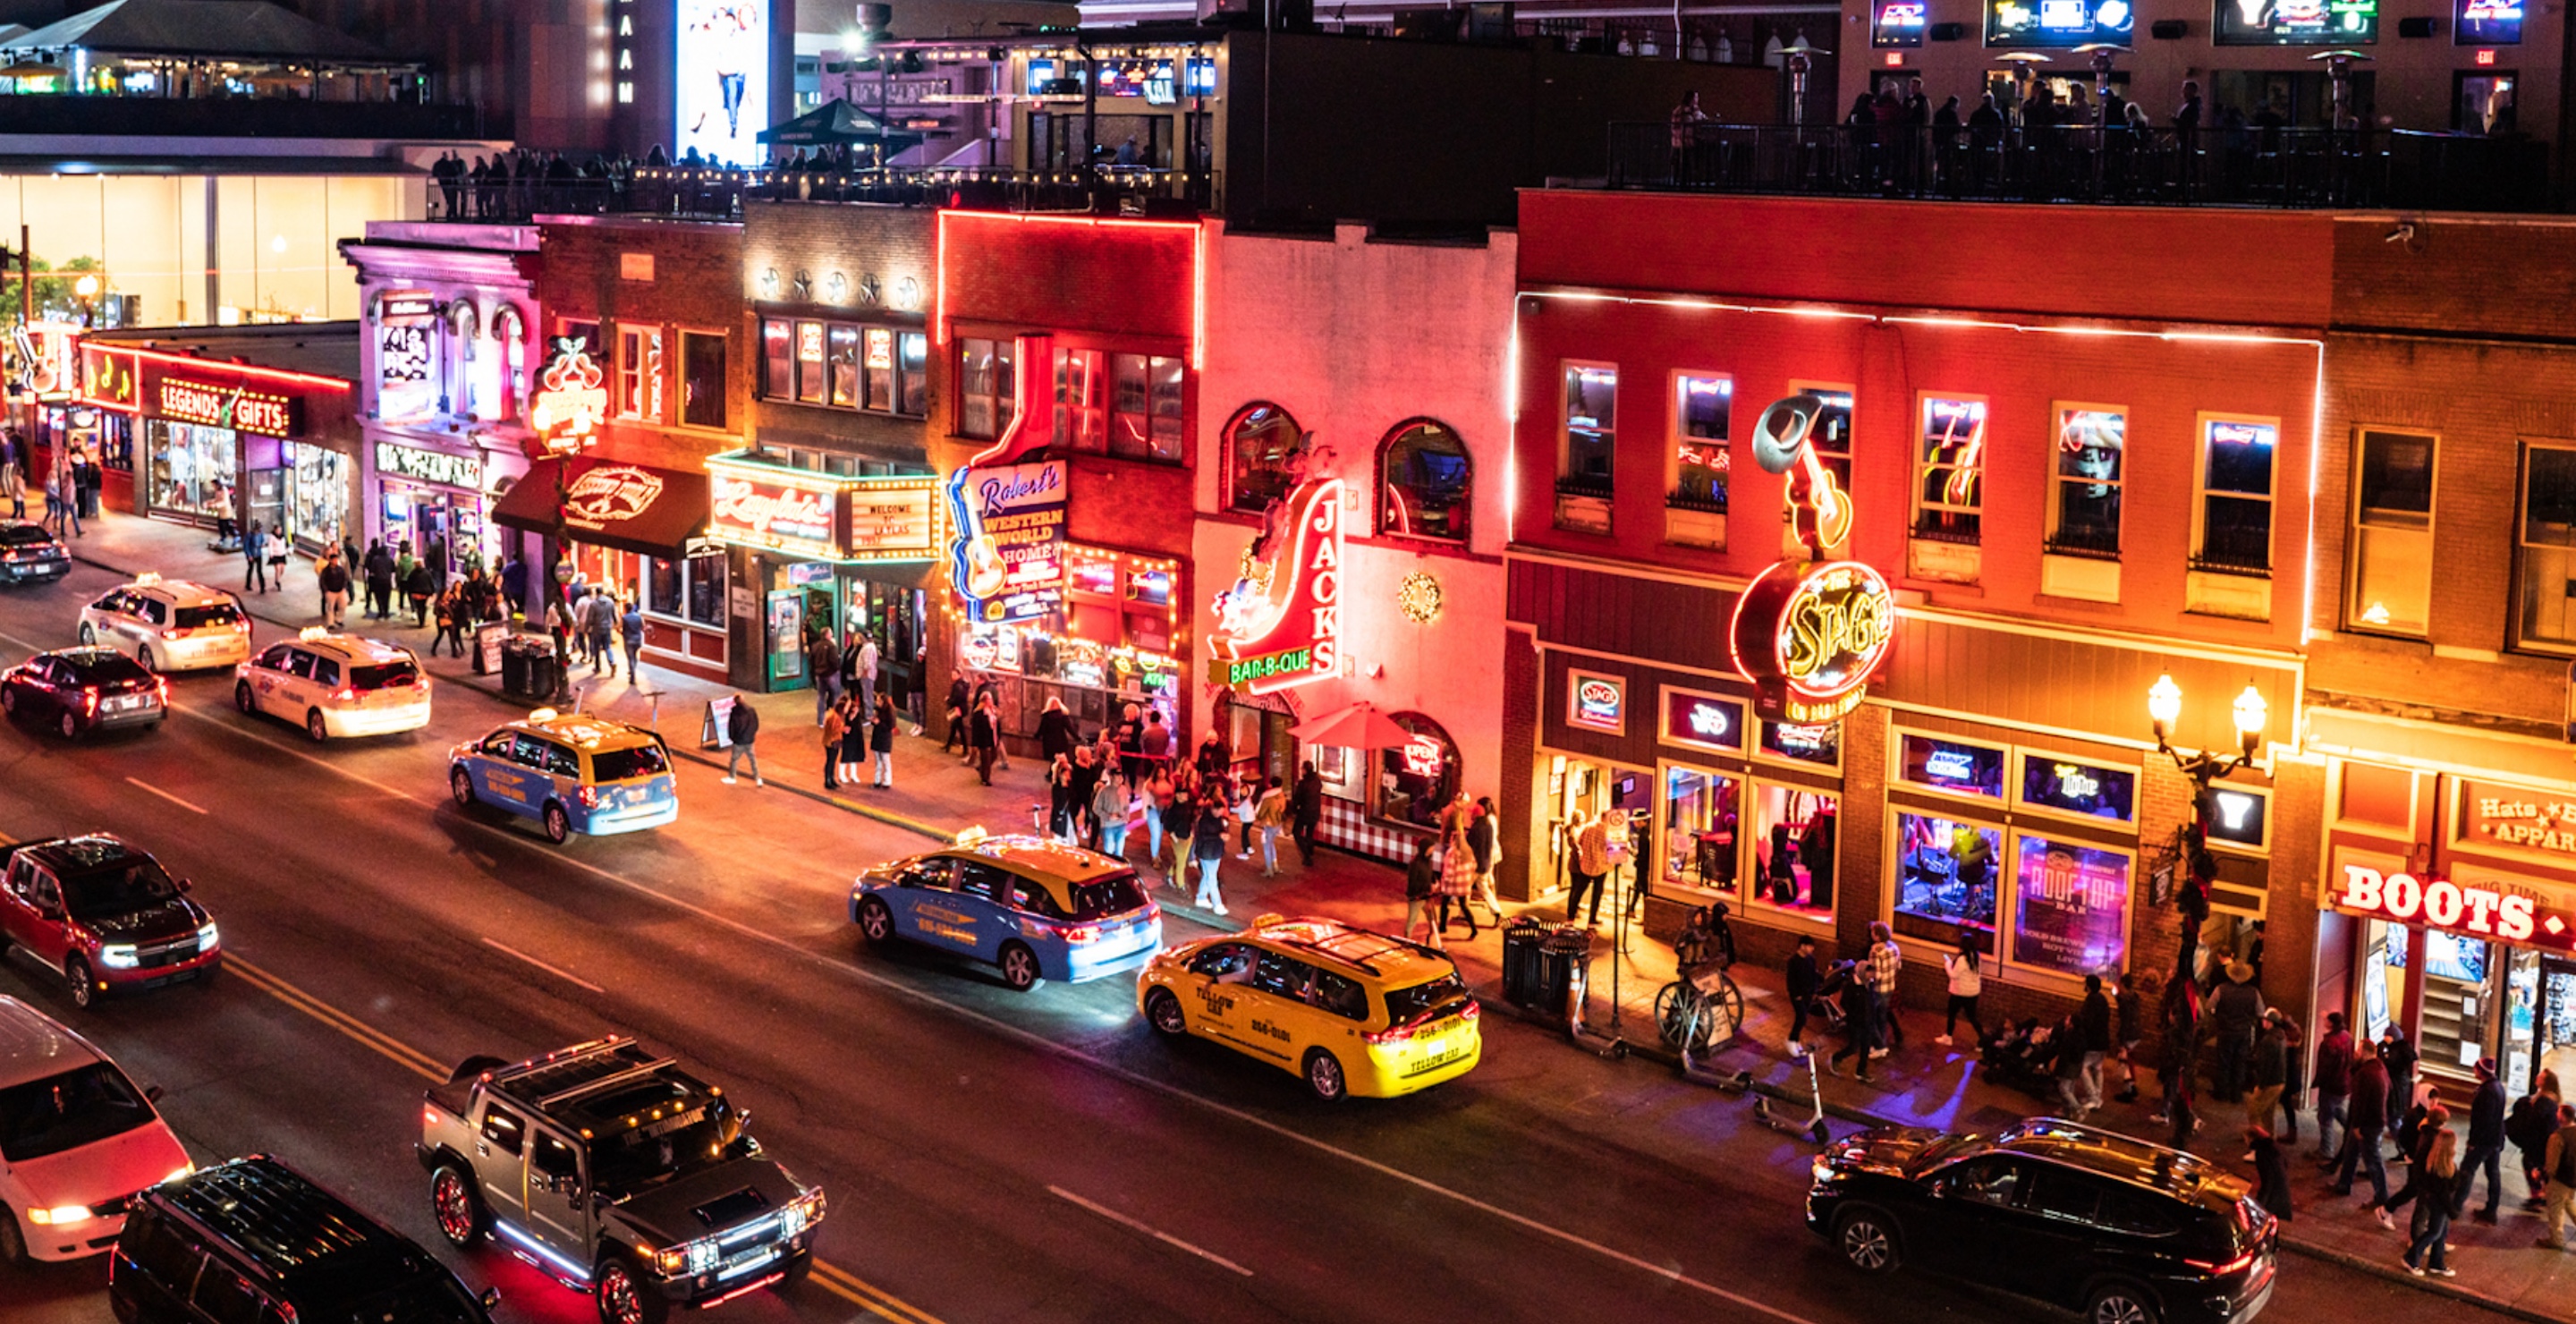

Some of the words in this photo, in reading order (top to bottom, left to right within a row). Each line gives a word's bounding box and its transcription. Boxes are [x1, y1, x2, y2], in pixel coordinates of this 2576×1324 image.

[163, 385, 220, 420] LEGENDS
[236, 398, 283, 429] GIFTS
[980, 464, 1060, 517] Robert's
[716, 480, 830, 533] Layla's
[869, 505, 911, 514] WELCOME
[983, 509, 1063, 532] WESTERN
[994, 526, 1054, 547] WORLD
[1004, 546, 1052, 564] HOME
[1309, 498, 1338, 675] JACKS
[1788, 590, 1891, 678] STAGE
[1229, 649, 1311, 684] BAR-B-QUE
[1584, 683, 1616, 703] STAGE
[1792, 701, 1807, 722] ON
[2480, 797, 2538, 818] Hats
[2342, 864, 2534, 940] BOOTS
[2507, 883, 2551, 905] TIME
[2055, 902, 2087, 914] BAR
[1196, 987, 1233, 1010] YELLOW
[1207, 1001, 1223, 1016] CAB
[1411, 1052, 1445, 1073] YELLOW
